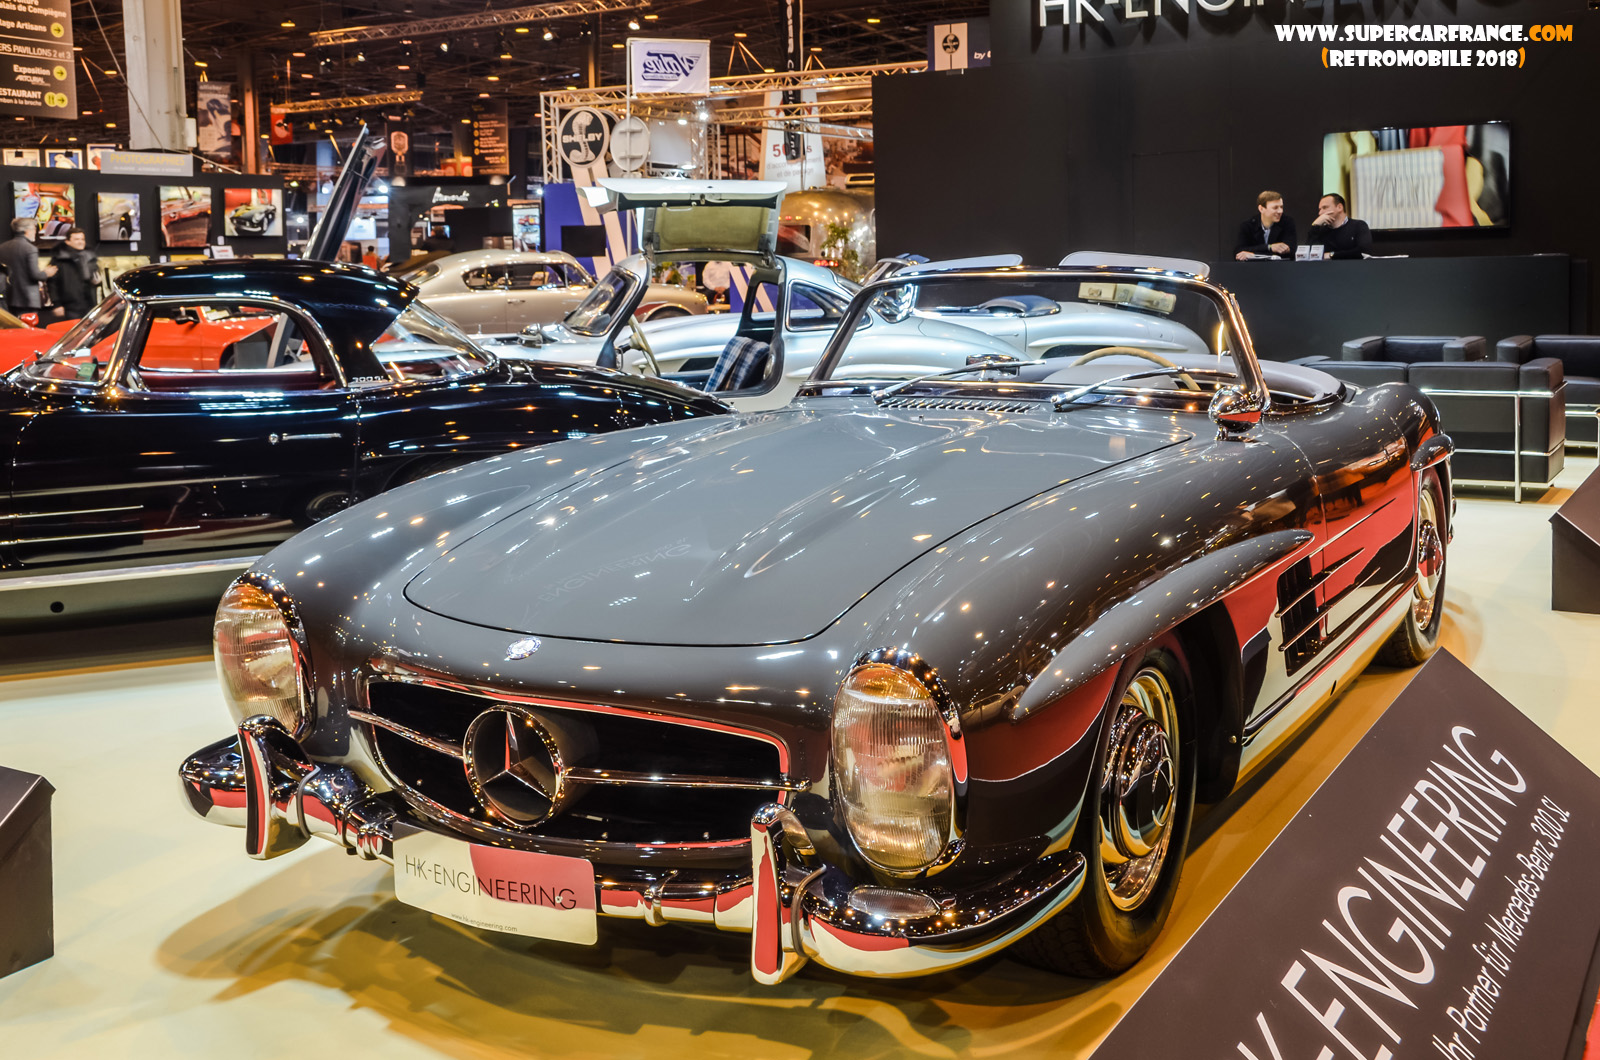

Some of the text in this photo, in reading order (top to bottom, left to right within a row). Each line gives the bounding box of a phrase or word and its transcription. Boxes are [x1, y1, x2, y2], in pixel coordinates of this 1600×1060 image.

[16, 20, 47, 32] Artisans
[13, 45, 52, 57] PAVILLONS
[974, 51, 986, 60] by
[13, 64, 51, 75] Exposition
[1541, 795, 1570, 823] SL
[1530, 808, 1564, 848] 300
[405, 854, 577, 910] HK-ENGINEERING
[1485, 839, 1554, 953] Mercedes-Benz
[1472, 941, 1512, 977] für
[1446, 966, 1502, 1044] Partner
